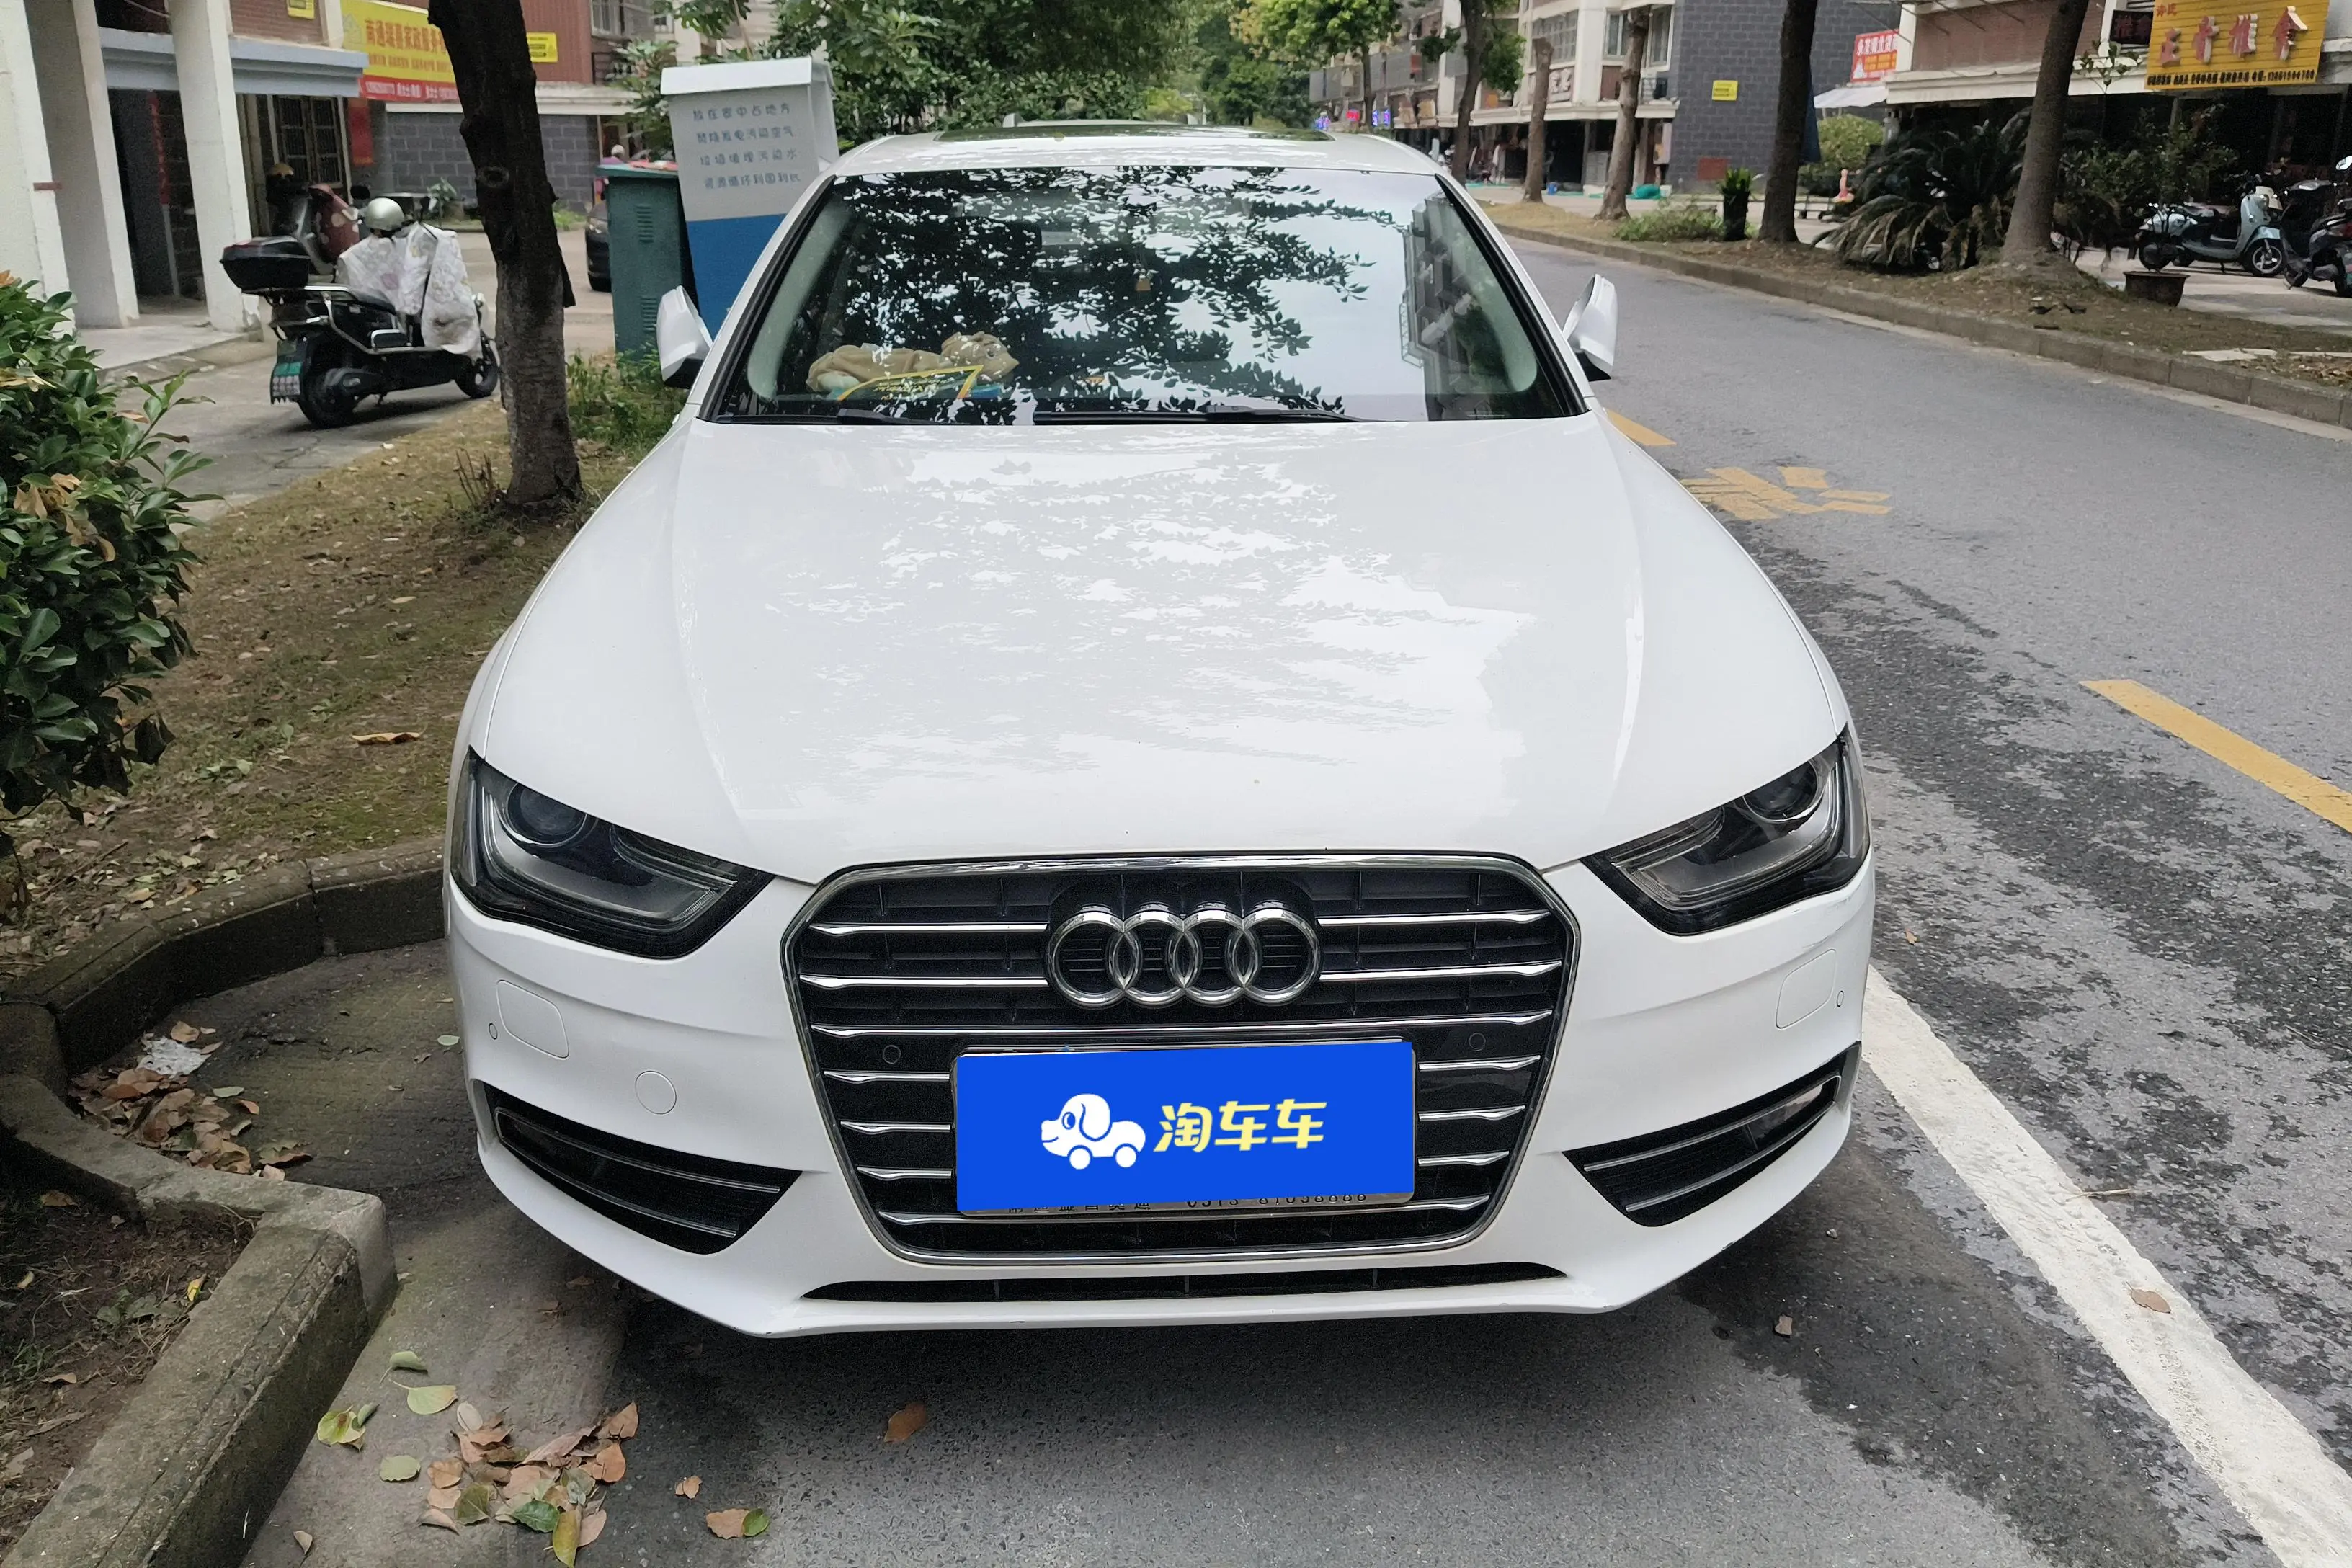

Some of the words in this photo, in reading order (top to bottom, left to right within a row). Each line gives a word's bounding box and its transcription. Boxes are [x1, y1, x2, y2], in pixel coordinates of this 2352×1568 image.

[693, 103, 790, 121] 放在家中占地方
[697, 125, 794, 144] 焚烧发电污染空气
[700, 148, 797, 166] 垃圾填埋污染水
[705, 172, 801, 189] 资源循环利国利民
